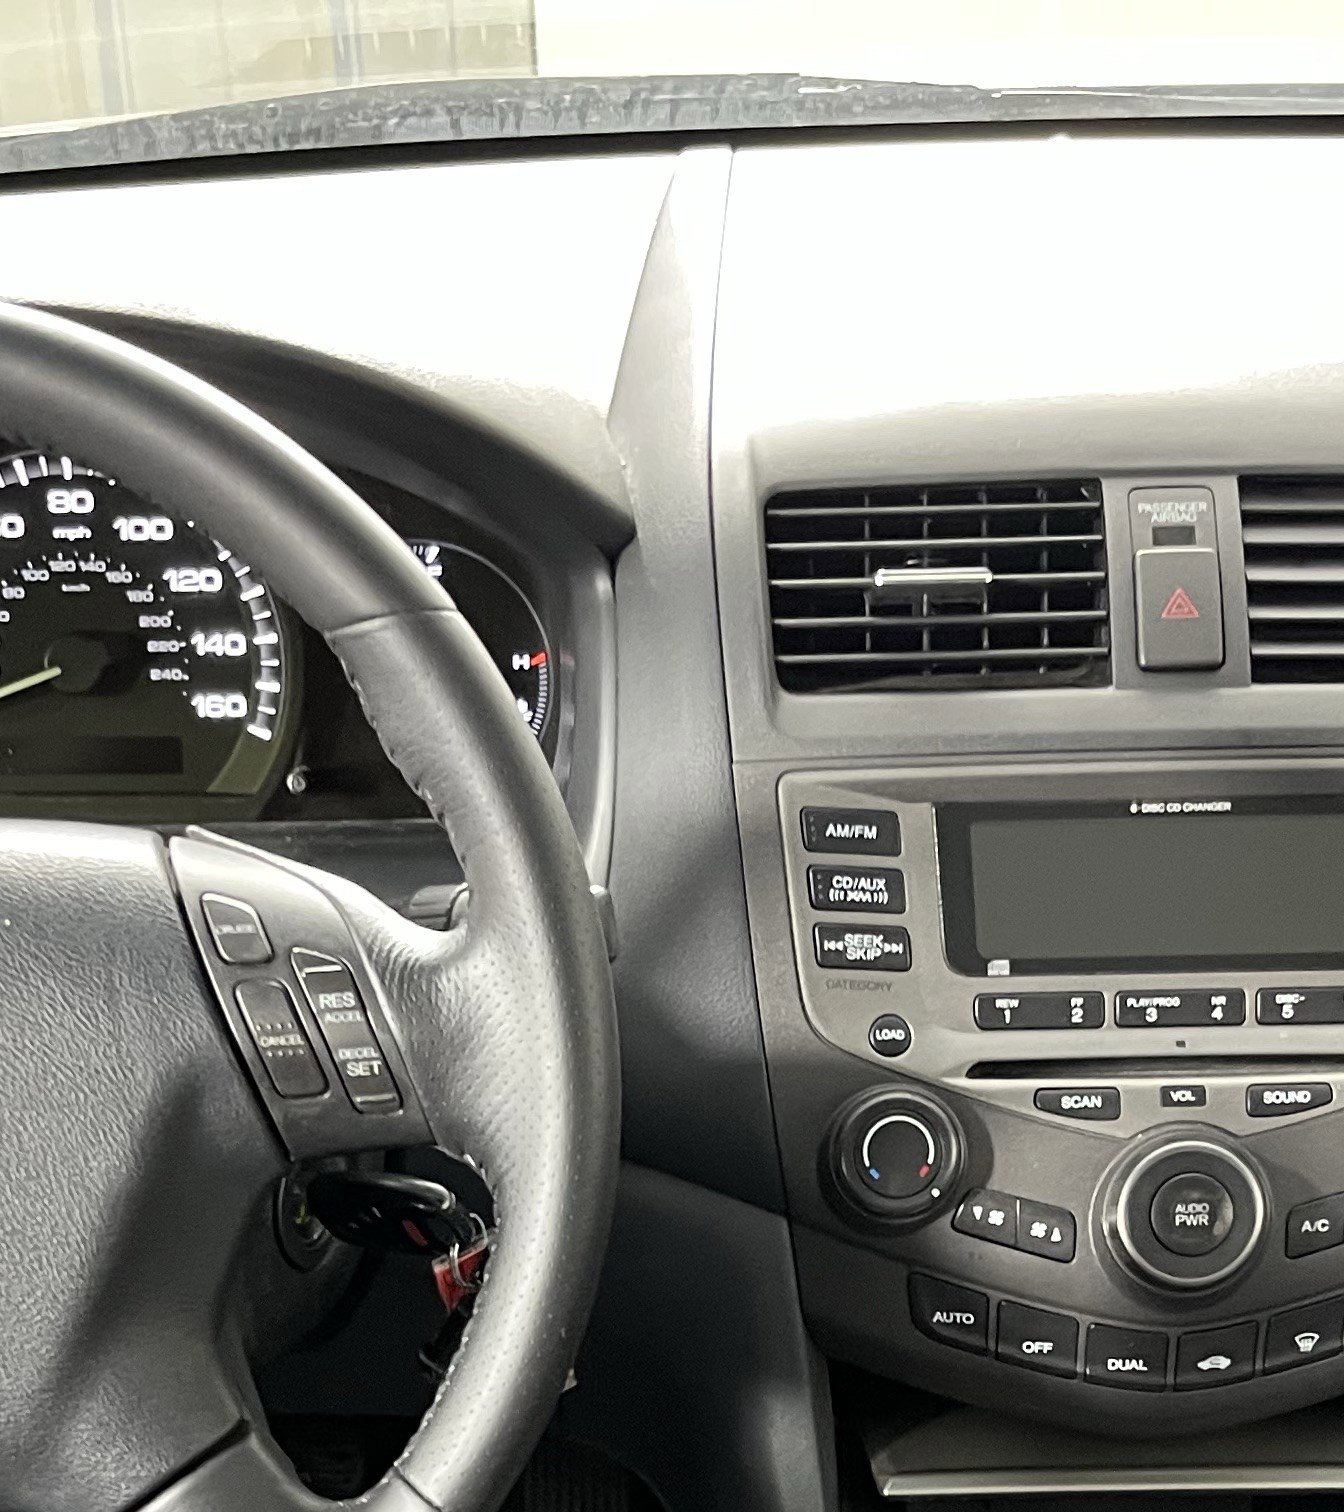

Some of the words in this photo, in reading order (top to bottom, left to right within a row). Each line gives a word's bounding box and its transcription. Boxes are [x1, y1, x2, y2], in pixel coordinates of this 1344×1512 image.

[46, 488, 95, 514] 80
[1138, 502, 1207, 513] PASSENGER
[52, 526, 92, 541] mph
[112, 515, 174, 541] 100
[162, 566, 223, 592] 120
[190, 632, 247, 656] 140
[512, 653, 531, 670] H
[191, 693, 248, 718] 160
[1166, 803, 1182, 812] CD
[1182, 802, 1232, 813] CHANGER
[826, 823, 877, 840] AM/FM
[832, 875, 886, 891] CD/AUX
[844, 933, 883, 949] SEEK
[846, 948, 881, 962] SKIP
[826, 978, 893, 992] CATEGORY
[319, 992, 355, 1009] RES
[1004, 1008, 1011, 1024] 1
[1071, 1007, 1083, 1023] 2
[1145, 1007, 1158, 1022] 3
[1211, 1006, 1223, 1020] 4
[1282, 1004, 1294, 1019] 5
[260, 1034, 304, 1047] CANCEL
[875, 1028, 905, 1041] LOAD
[346, 1061, 382, 1077] SET
[1061, 1095, 1102, 1109] SCAN
[1169, 1090, 1196, 1103] VOL
[1263, 1090, 1311, 1104] SOUND
[1175, 1203, 1209, 1215] AUDIO
[1175, 1213, 1209, 1226] PWR
[1301, 1219, 1329, 1233] A/C
[932, 1311, 974, 1325] AUTO
[1022, 1341, 1053, 1354] OFF
[1107, 1358, 1148, 1372] DUAL
